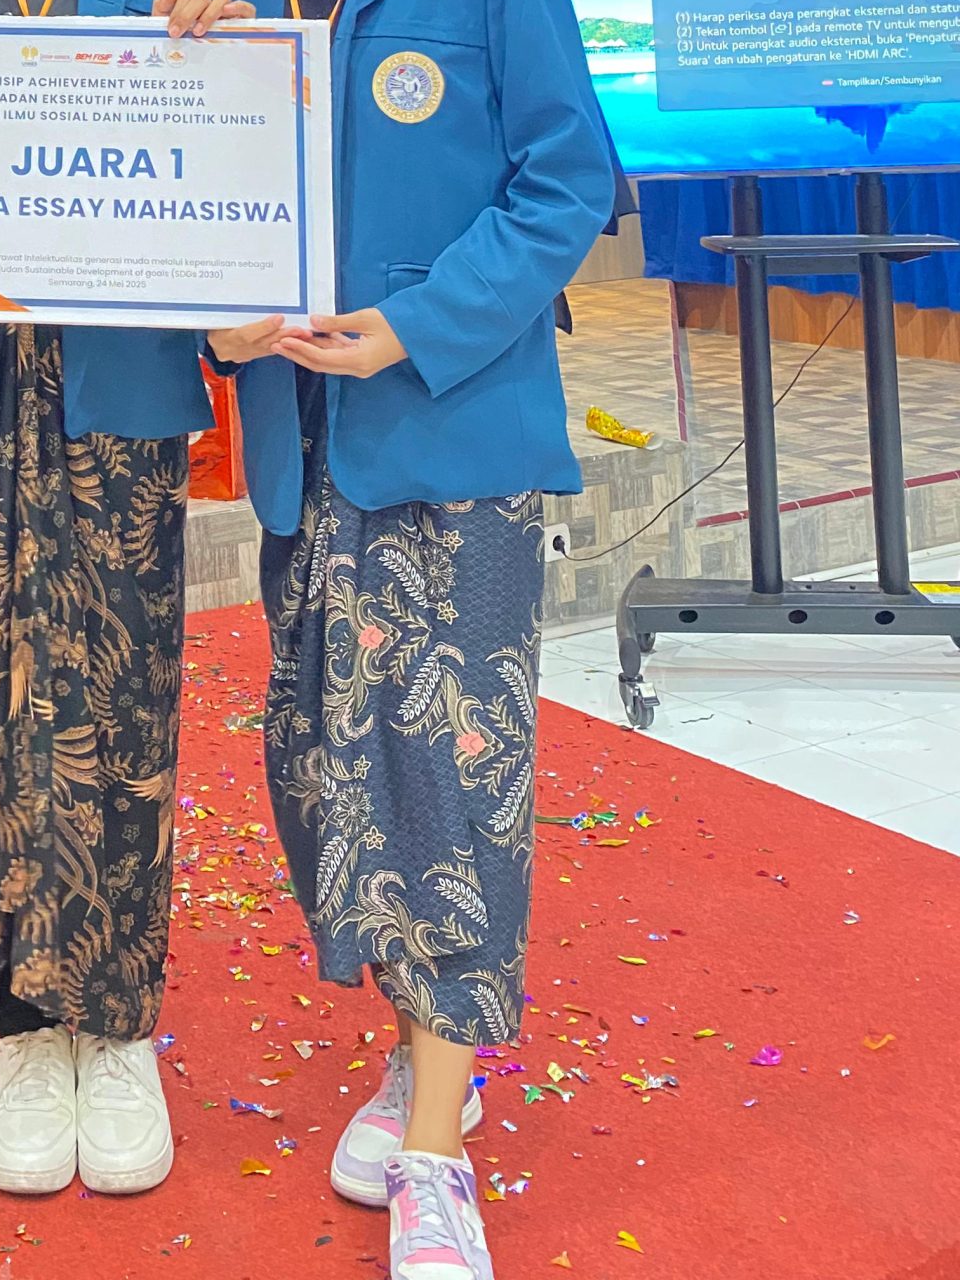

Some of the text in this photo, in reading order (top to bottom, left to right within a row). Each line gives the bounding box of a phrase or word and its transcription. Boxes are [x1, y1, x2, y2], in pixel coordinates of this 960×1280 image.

[676, 11, 690, 25] (1)
[693, 12, 725, 24] Harap
[728, 11, 766, 23] periksa
[769, 9, 794, 21] daya
[797, 7, 851, 20] perangkat
[854, 5, 904, 16] eksternal
[907, 4, 927, 14] dan
[676, 25, 693, 39] (2)
[695, 26, 726, 36] Tekan
[729, 24, 767, 35] tombol
[795, 22, 821, 35] pada
[824, 21, 863, 32] remote
[866, 20, 882, 30] TV
[884, 18, 916, 30] untuk
[677, 40, 694, 53] (3)
[696, 40, 729, 51] Untuk
[732, 38, 785, 52] perangkat
[788, 37, 818, 48] audio
[820, 35, 874, 46] eksternal,
[876, 34, 903, 44] buka
[678, 48, 913, 66] Suara' dan ubah pengaturan ke 'HDMI ARC'.
[28, 77, 125, 89] ACHIEVEMENT
[130, 79, 167, 89] WEEK
[171, 80, 205, 90] 2025
[837, 74, 942, 88] Tampilkan/Sembunyikan
[42, 94, 114, 105] EKSEKUTIF
[118, 96, 205, 107] MAHASISWA
[3, 110, 36, 120] ILMU
[40, 110, 88, 121] SOSIAL
[92, 112, 121, 122] DAN
[126, 113, 159, 123] ILMU
[163, 113, 215, 124] POLITIK
[220, 114, 266, 125] UNNES
[11, 146, 183, 180] JUARA 1
[18, 196, 105, 218] ESSAY
[113, 199, 292, 223] MAHASISWA
[24, 253, 83, 263] Intelektualitas
[85, 256, 123, 265] generasi
[123, 257, 150, 265] muda
[151, 258, 183, 266] melalui
[185, 258, 237, 268] kepenulisan
[238, 260, 274, 270] sebagai
[25, 266, 74, 274] Sustainable
[76, 267, 133, 277] Development
[135, 269, 144, 277] of
[145, 269, 169, 279] goals
[199, 269, 224, 280] 2030)
[48, 278, 147, 288] Semarang, 24 Mei 2025
